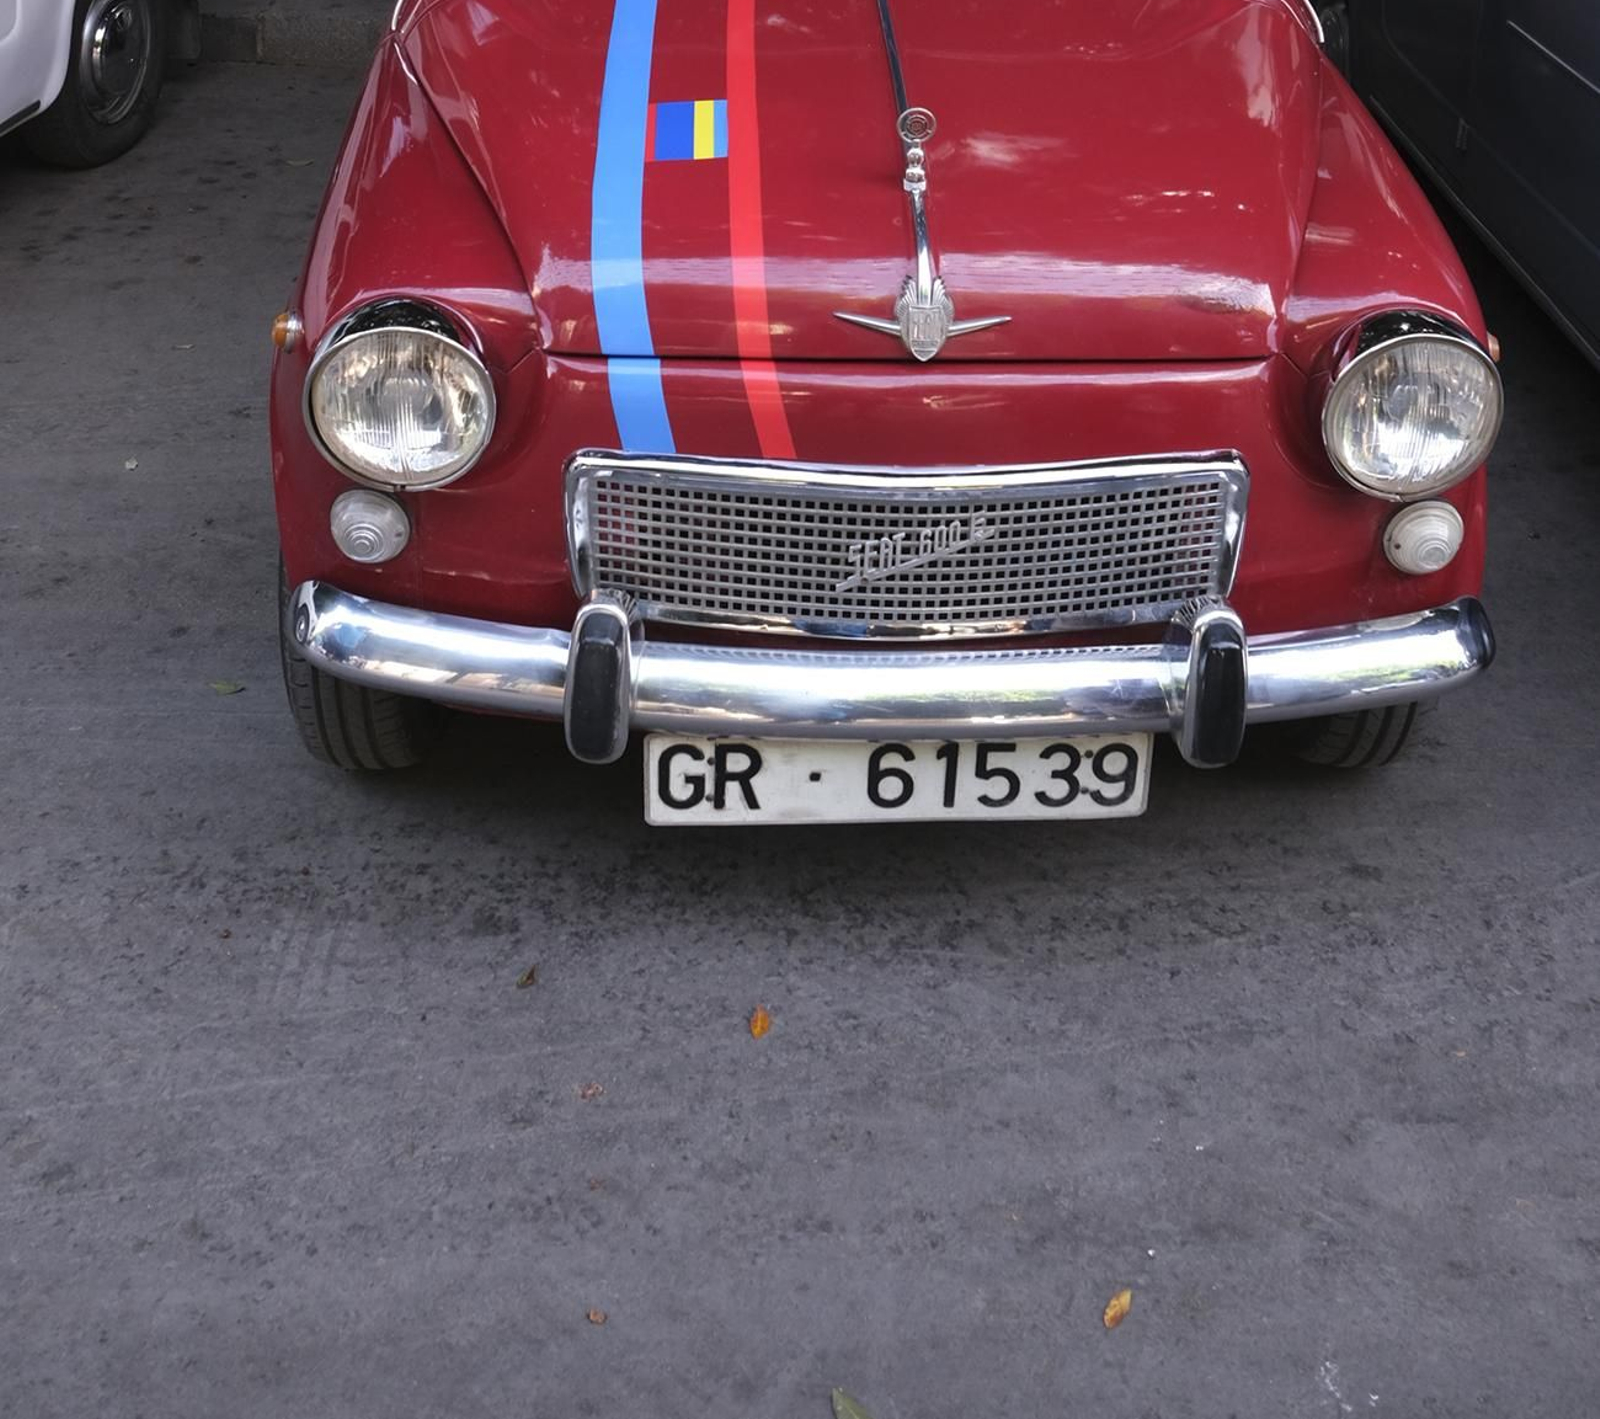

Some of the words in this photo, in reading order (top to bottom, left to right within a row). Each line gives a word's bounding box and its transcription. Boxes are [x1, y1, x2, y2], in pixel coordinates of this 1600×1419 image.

[847, 531, 906, 581] SEAT
[920, 519, 961, 556] 600
[657, 742, 763, 810] GR
[867, 742, 1140, 809] 61539
